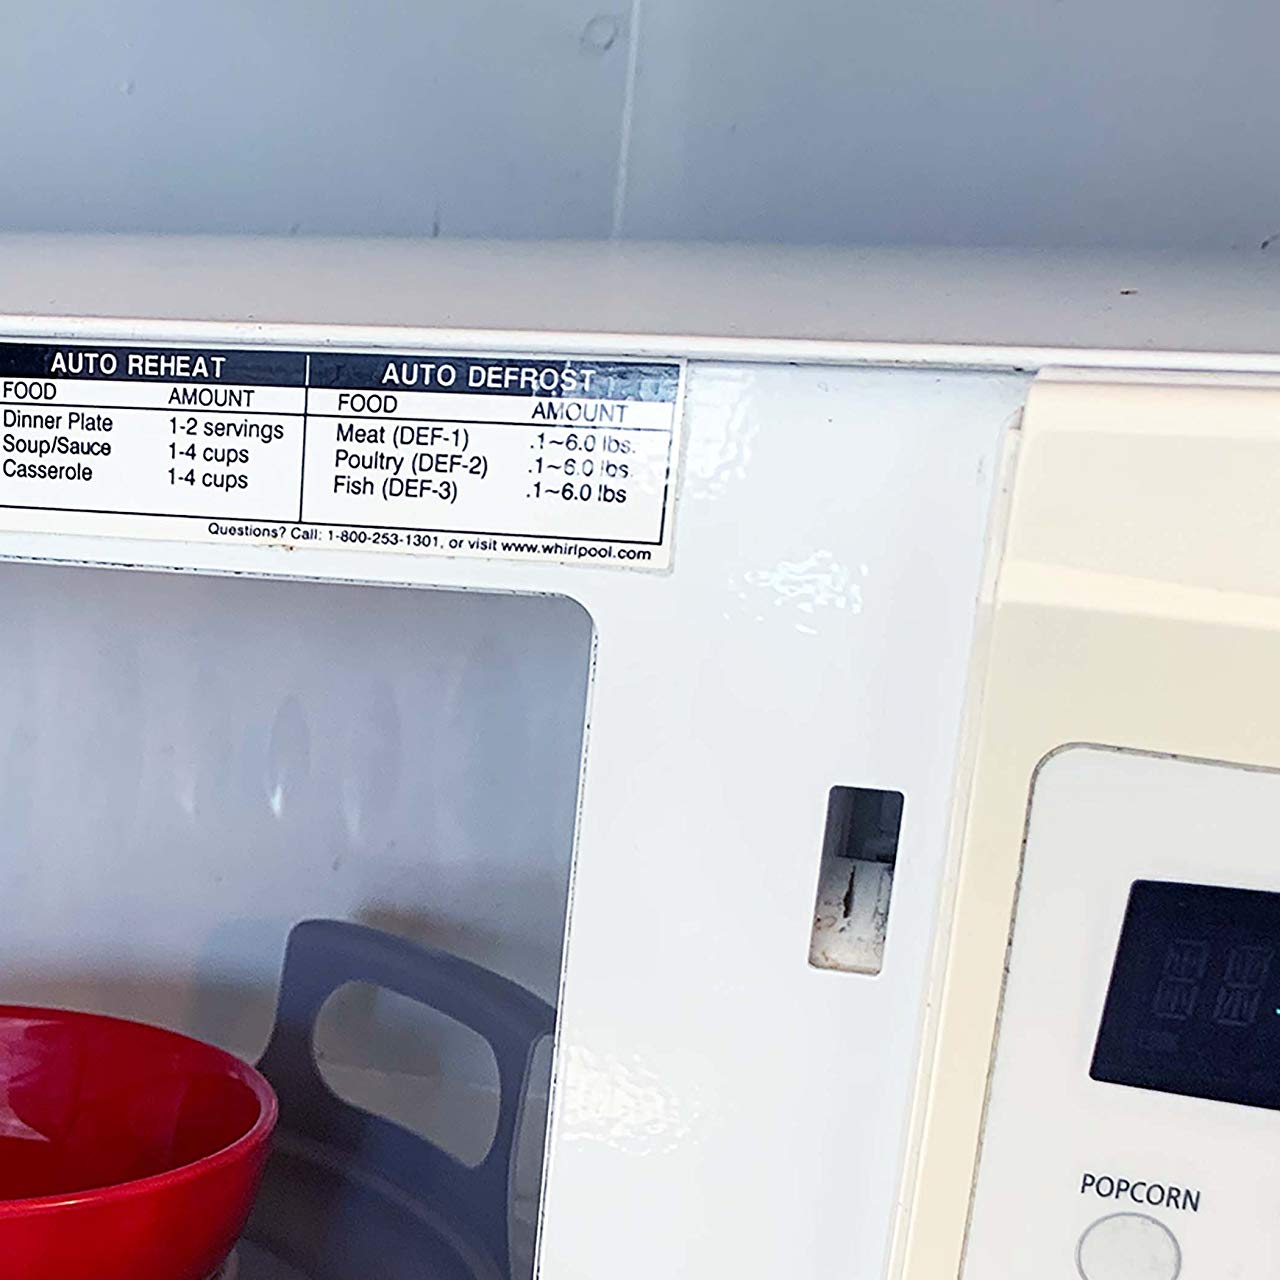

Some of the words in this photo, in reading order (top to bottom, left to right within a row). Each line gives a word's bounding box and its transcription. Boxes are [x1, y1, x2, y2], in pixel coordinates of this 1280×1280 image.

[50, 351, 117, 375] AUTO
[128, 354, 227, 378] REHEAT
[382, 361, 457, 386] AUTO
[468, 364, 597, 393] DEFROST
[3, 381, 57, 400] FOOD
[167, 387, 255, 407] AMOUNT
[337, 393, 398, 413] FOOD
[530, 400, 629, 424] AMOUNT
[3, 409, 63, 431] Dinner
[68, 412, 114, 432] Plate
[169, 417, 198, 436] 1-2
[203, 420, 284, 444] servings
[2, 434, 112, 457] Soup/Sauce
[336, 423, 386, 444] Meat
[392, 425, 469, 451] (DEF-1)
[530, 432, 596, 453] .1~6.0
[168, 442, 197, 461] 1-4
[203, 446, 249, 467] cups
[334, 449, 404, 476] Poultry
[411, 451, 489, 480] (DEF-2)
[3, 459, 93, 481] Casserole
[528, 457, 594, 478] .1~6.0
[168, 467, 197, 486] 1-4
[202, 471, 249, 493] cups
[333, 476, 375, 496] Fish
[382, 478, 459, 504] (DEF-3)
[526, 482, 592, 502] .1~6.0
[208, 522, 287, 540] Questions?
[290, 527, 322, 541] Call:
[448, 537, 464, 550] or
[467, 537, 498, 552] visit
[501, 539, 652, 562] www.whirlpool.com
[1080, 1172, 1201, 1213] POPCORN
